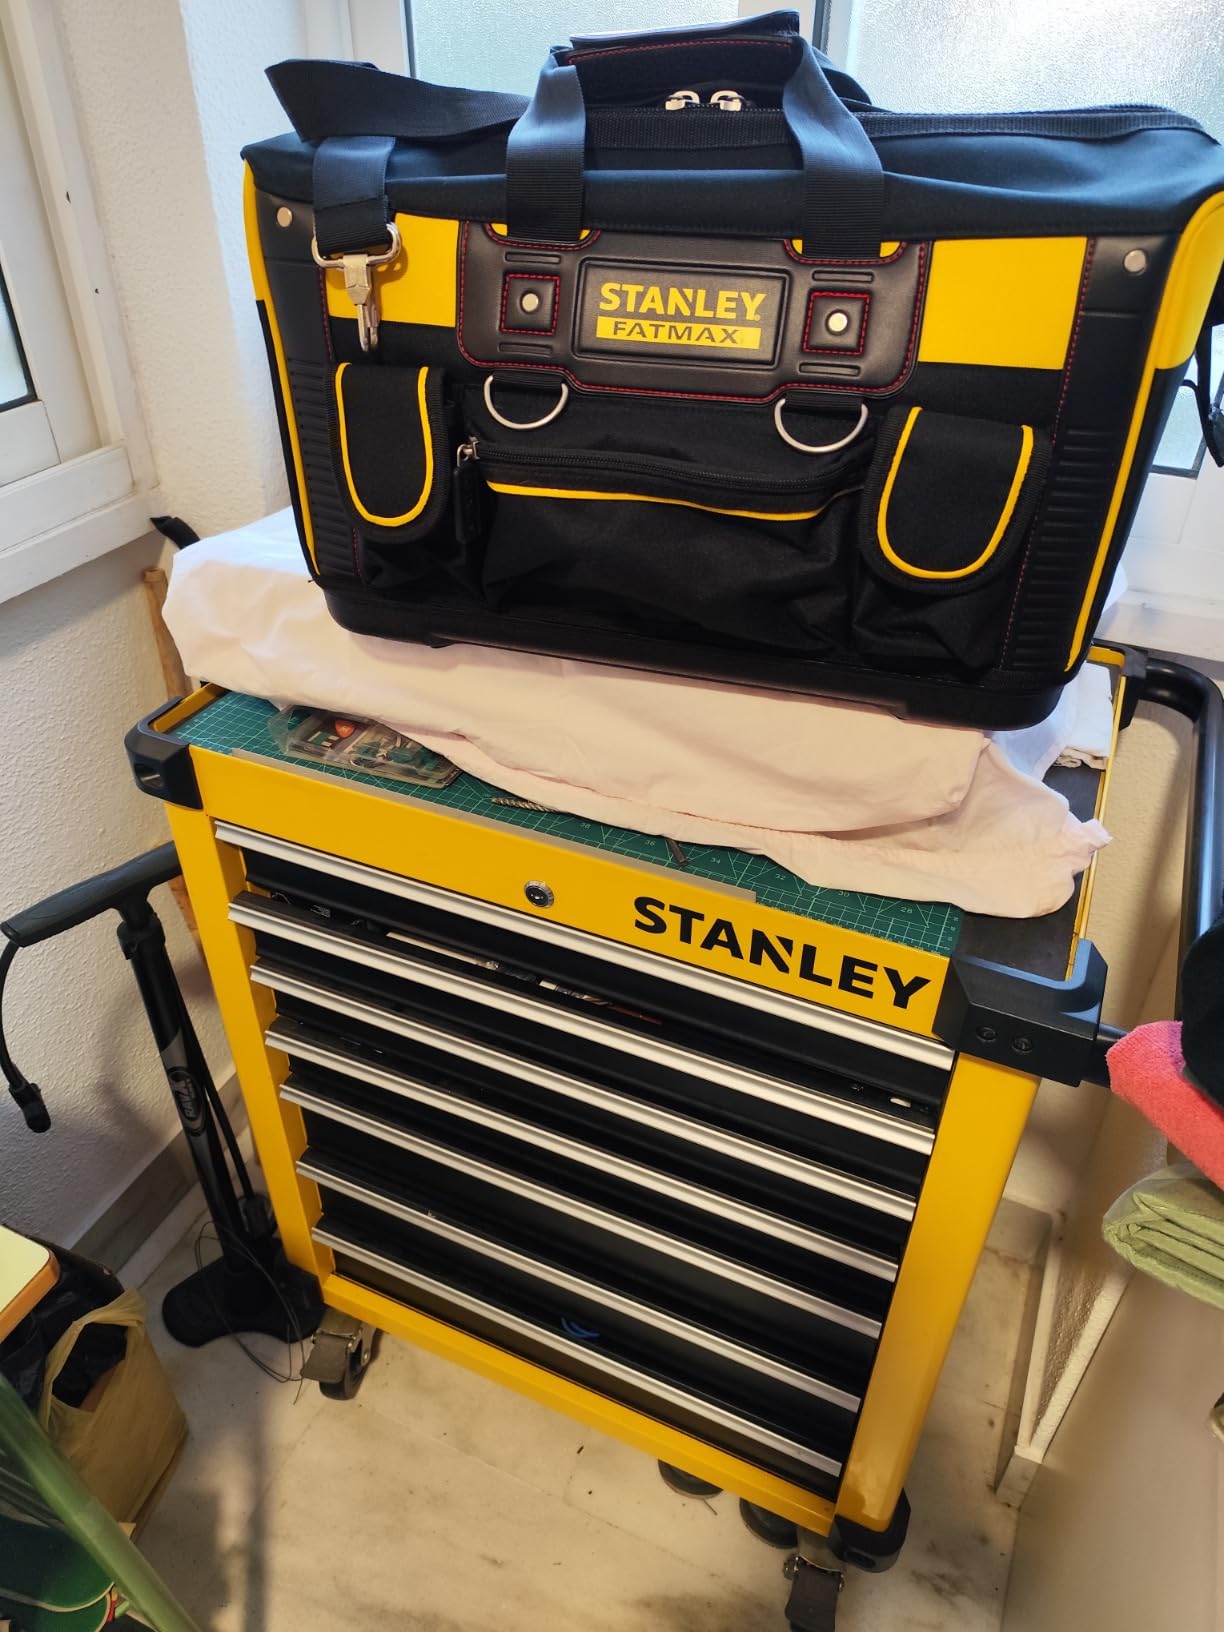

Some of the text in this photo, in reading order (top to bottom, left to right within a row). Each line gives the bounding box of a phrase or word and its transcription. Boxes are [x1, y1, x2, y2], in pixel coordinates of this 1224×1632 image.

[599, 282, 767, 321] STANLEY
[613, 321, 740, 344] FATMAX
[633, 896, 931, 1010] STANLEY
